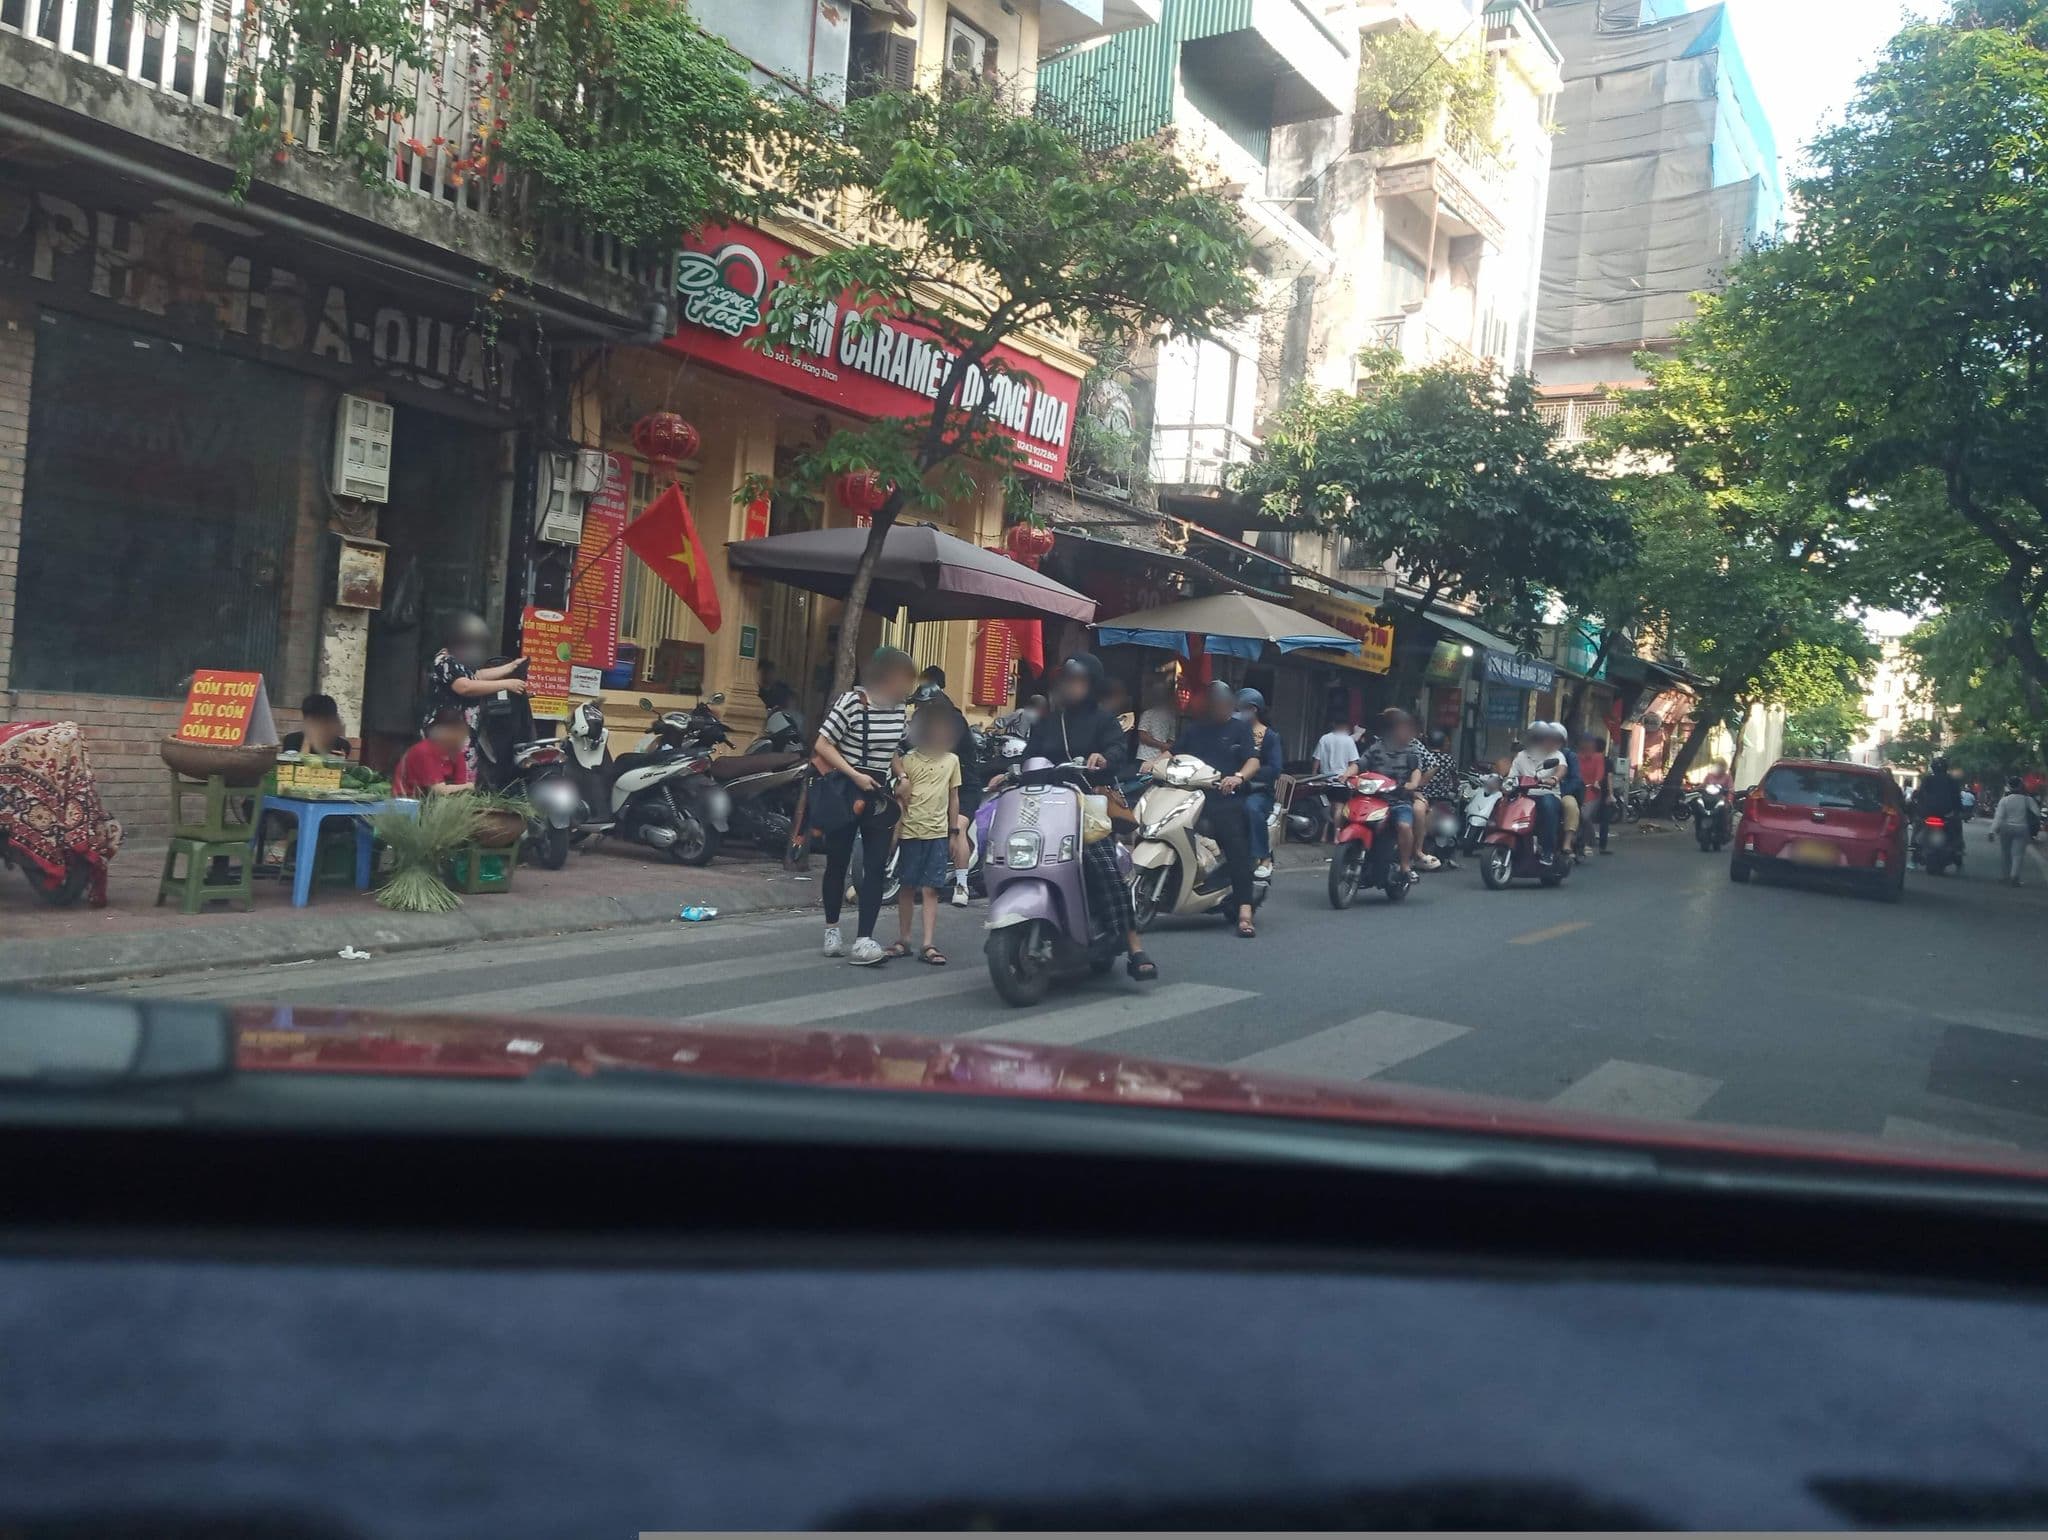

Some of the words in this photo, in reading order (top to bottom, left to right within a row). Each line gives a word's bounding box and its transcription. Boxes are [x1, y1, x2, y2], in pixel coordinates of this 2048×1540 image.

[1030, 391, 1069, 447] HOA
[192, 676, 221, 695] CỐM
[223, 681, 256, 697] TƯƠI
[190, 700, 215, 717] XÔI
[216, 699, 246, 719] CỐM
[182, 719, 211, 738] CỐM
[211, 723, 240, 740] XÀO
